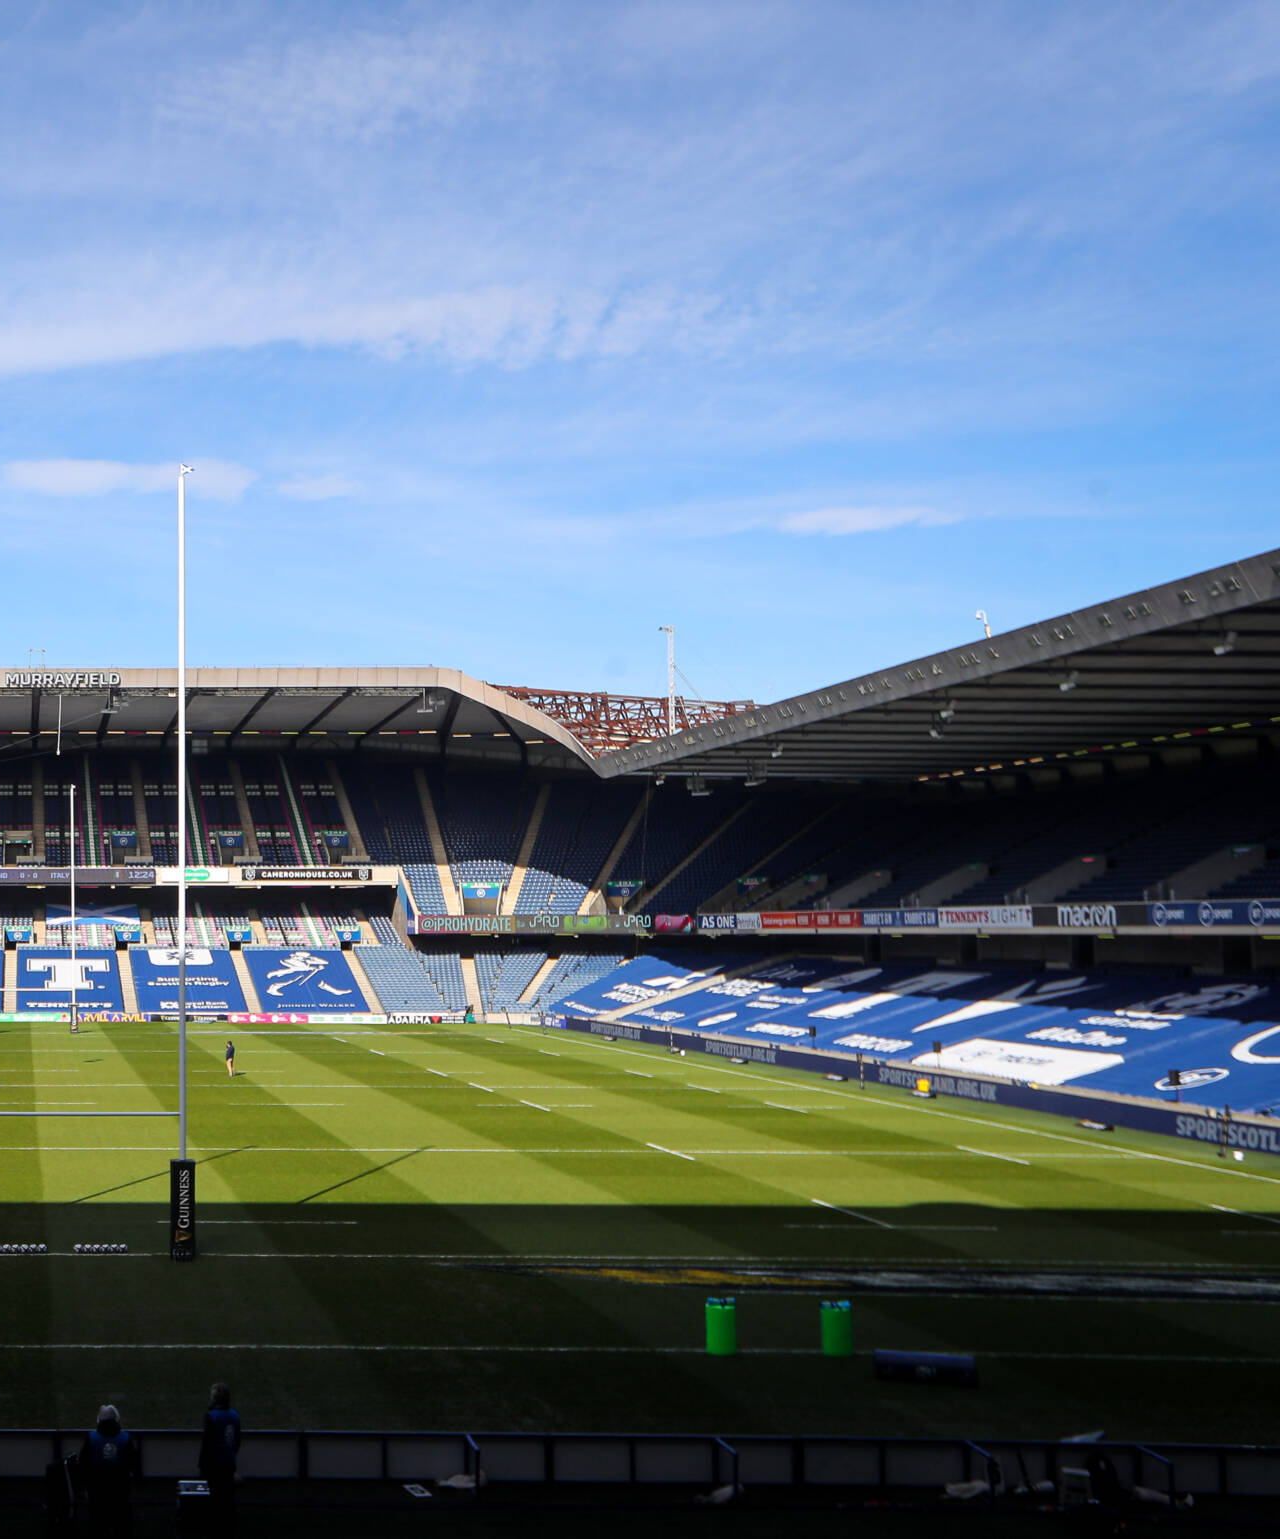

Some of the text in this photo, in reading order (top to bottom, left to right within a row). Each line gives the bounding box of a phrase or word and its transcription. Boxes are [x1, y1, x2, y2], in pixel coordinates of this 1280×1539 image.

[5, 672, 121, 686] MURRAYFIELD
[128, 871, 155, 879] 12:24
[261, 871, 353, 879] CAMERONHOUSE.CO.UK
[701, 915, 736, 929] AS ONE
[1057, 905, 1117, 927] macron
[421, 917, 512, 932] @iPROHYDRATE
[388, 1016, 432, 1024] ADARMA
[705, 1040, 777, 1063] SPORTSCOTLAND.ORG.UK
[879, 1067, 997, 1101] SPORTSCLAND.ORG.UK
[177, 1169, 190, 1229] GUINNESS
